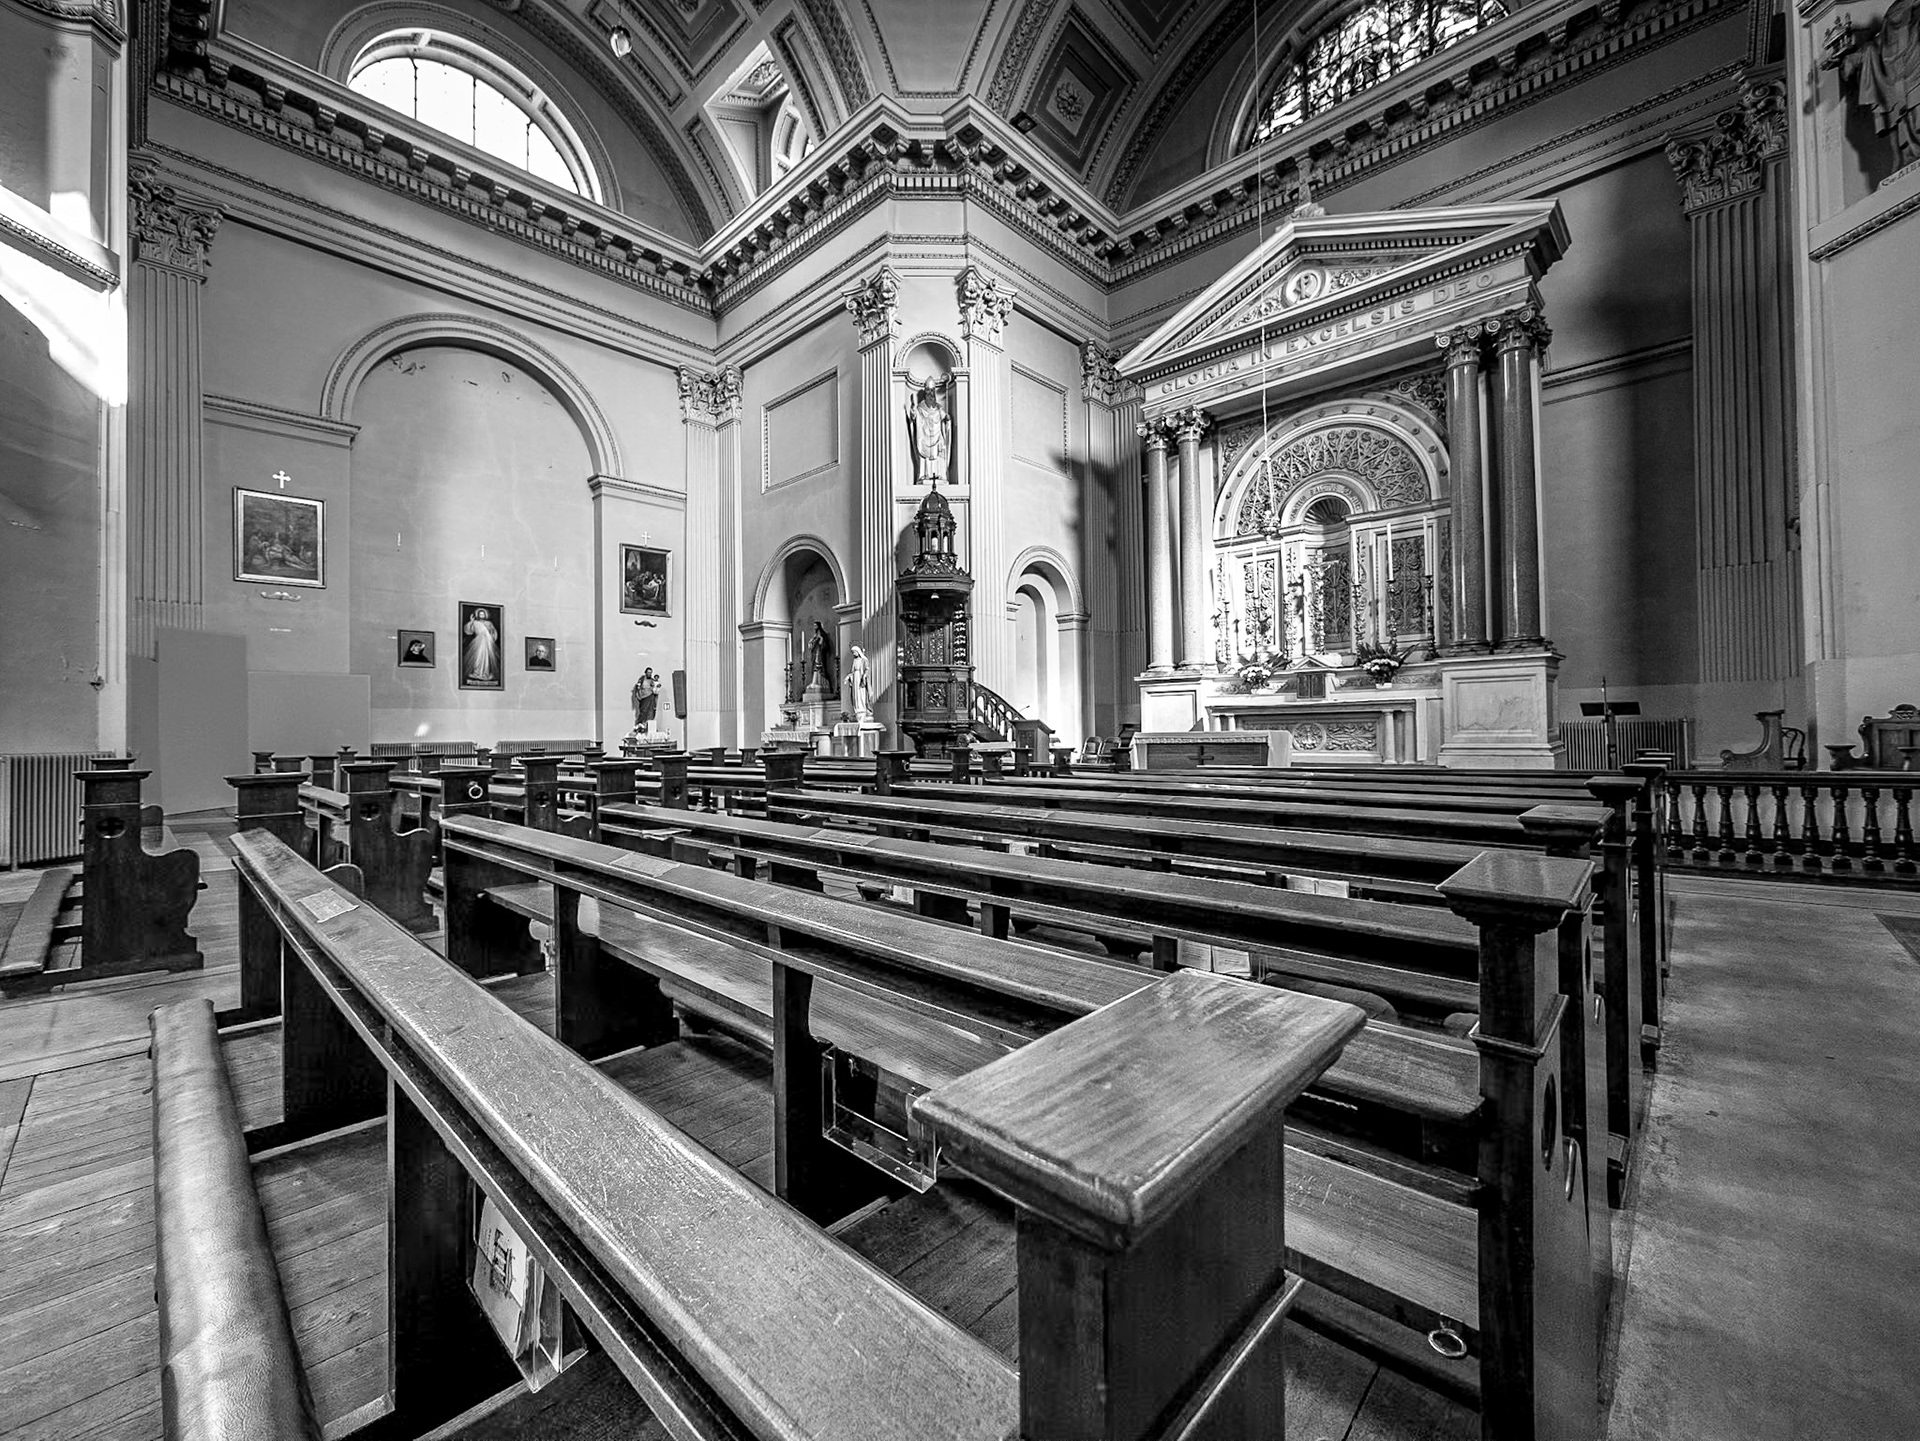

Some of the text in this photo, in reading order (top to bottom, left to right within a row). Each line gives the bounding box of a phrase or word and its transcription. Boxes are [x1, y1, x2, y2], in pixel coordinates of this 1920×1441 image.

[1161, 271, 1494, 395] GLORIA IN EXCELSIS DEO
